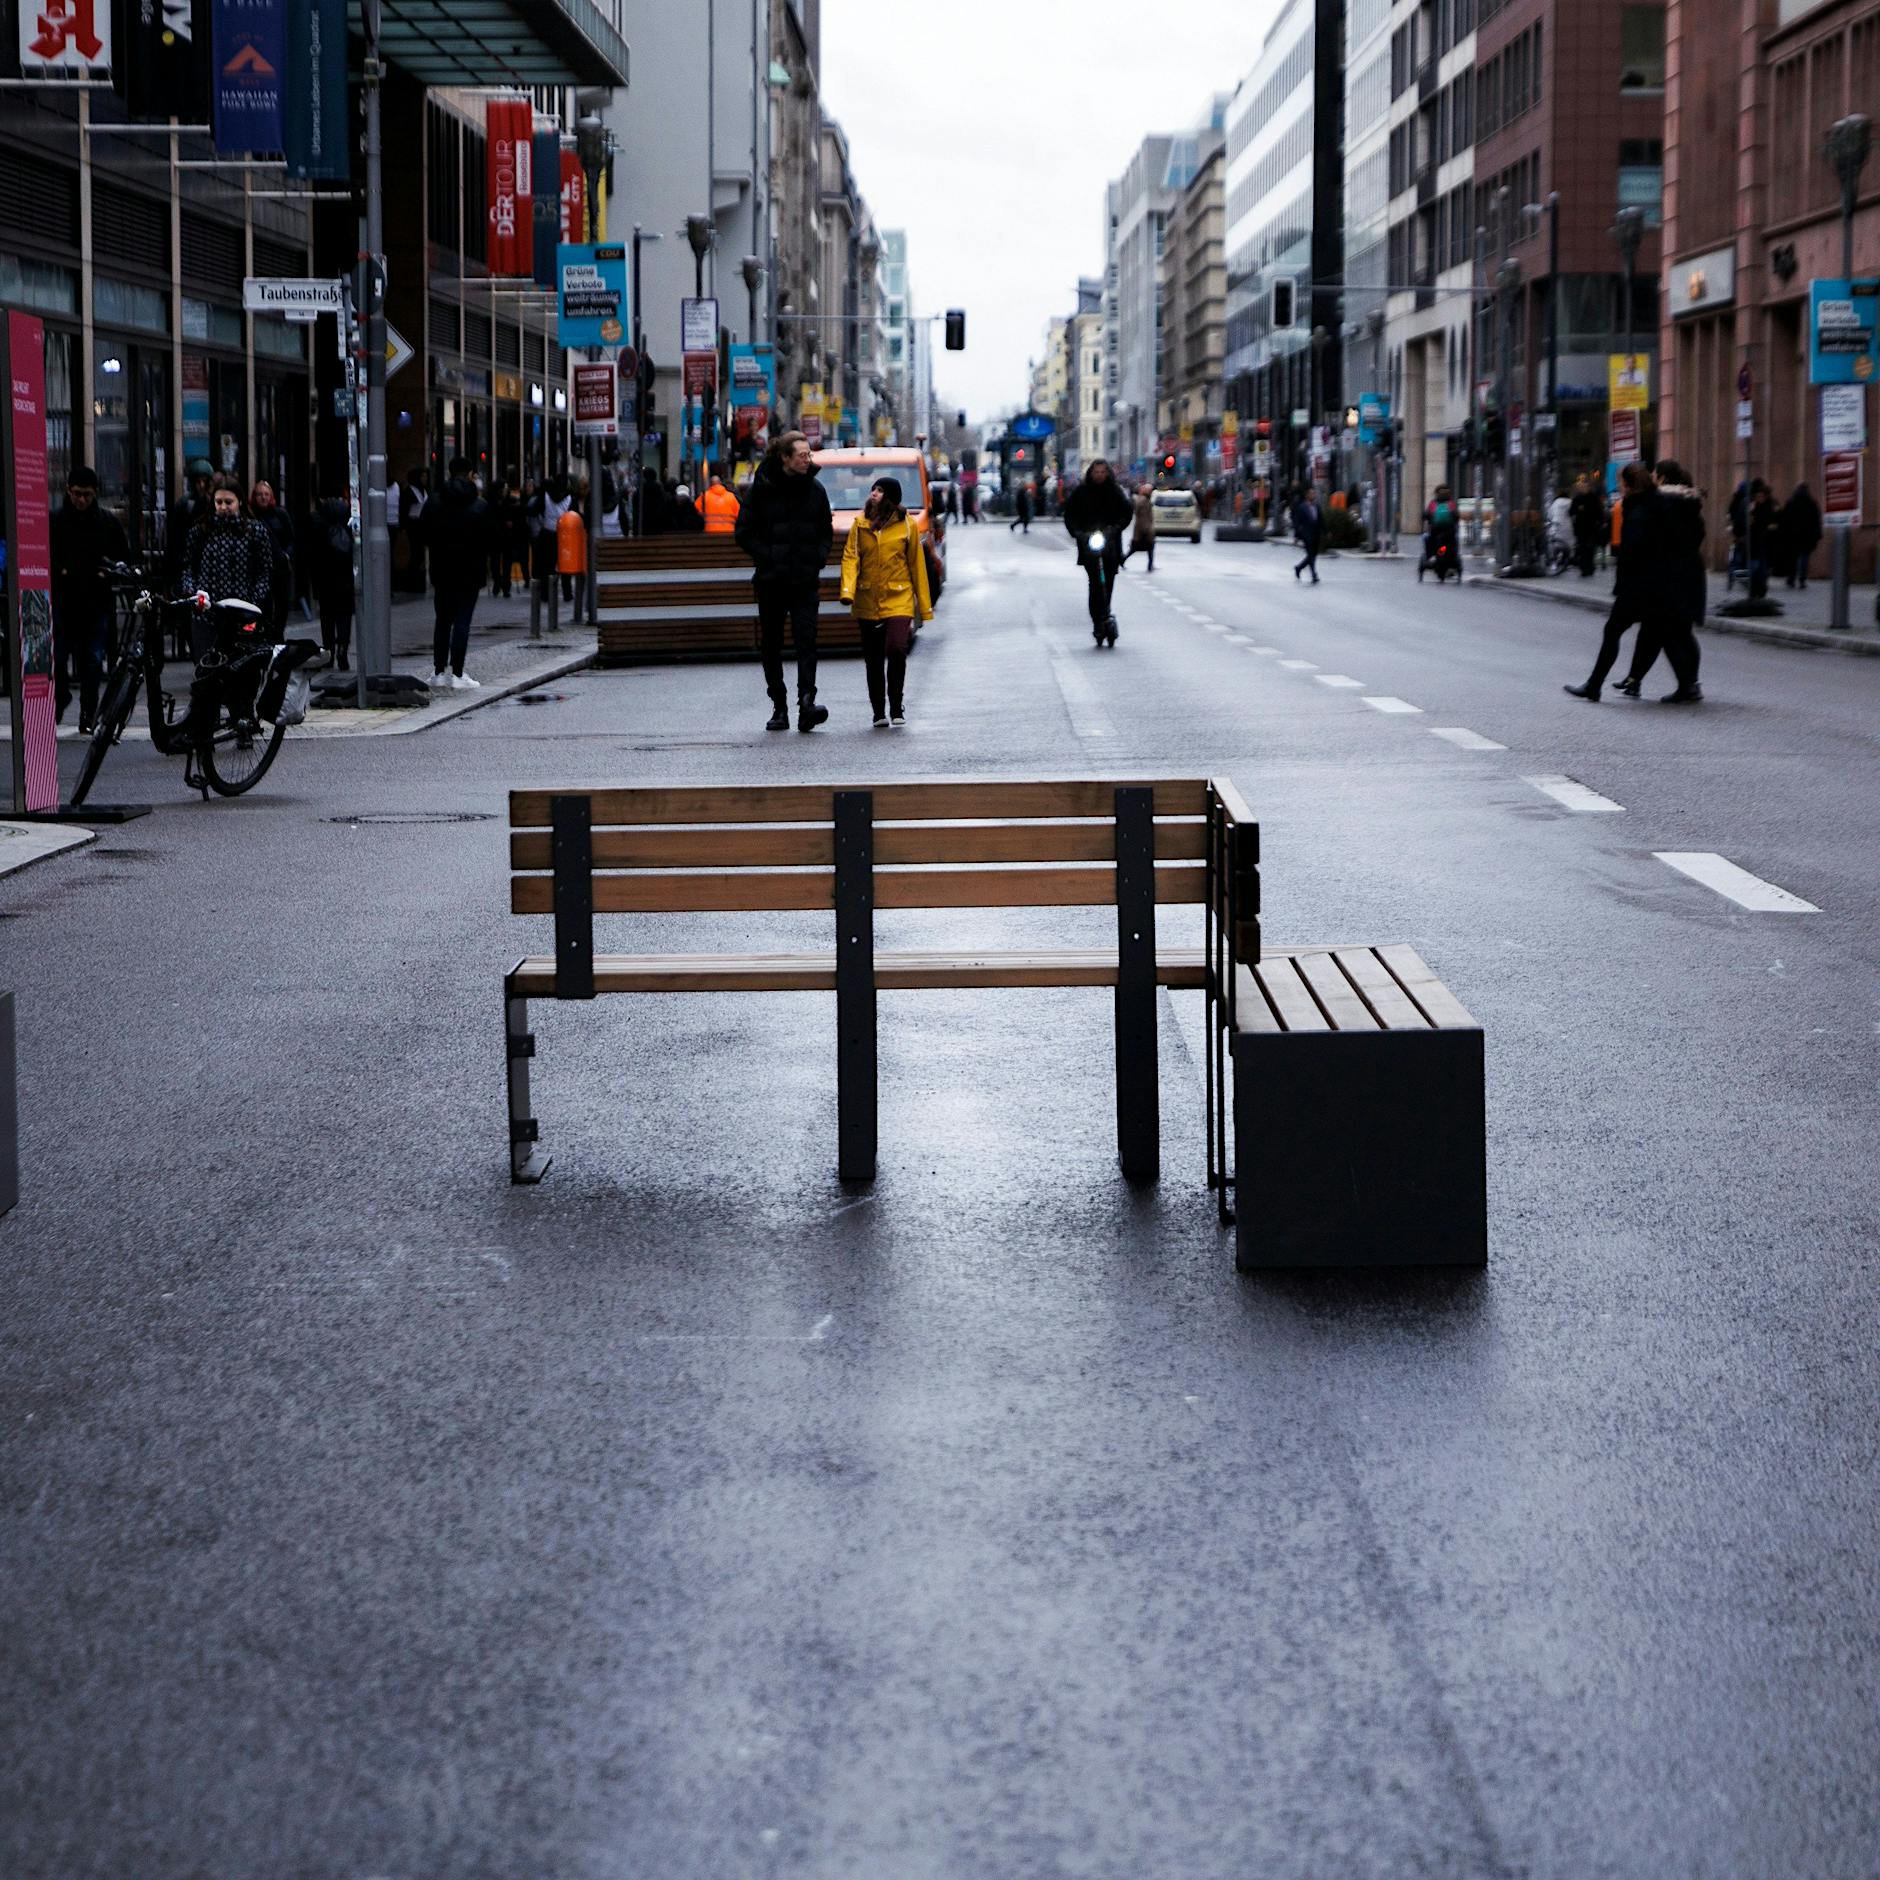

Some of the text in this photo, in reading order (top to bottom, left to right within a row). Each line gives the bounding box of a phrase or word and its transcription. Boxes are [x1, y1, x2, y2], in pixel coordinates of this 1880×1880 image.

[309, 9, 322, 155] Urbanes Leben im Quadrat
[221, 90, 279, 101] HAWAIIAN
[518, 142, 528, 193] Reisebüro
[495, 138, 515, 237] DERTOUR
[571, 174, 580, 204] CITY
[566, 266, 594, 276] Grüne
[566, 280, 603, 289] Verbote
[257, 285, 342, 303] Taubenstraße
[566, 292, 620, 304] weiträumig
